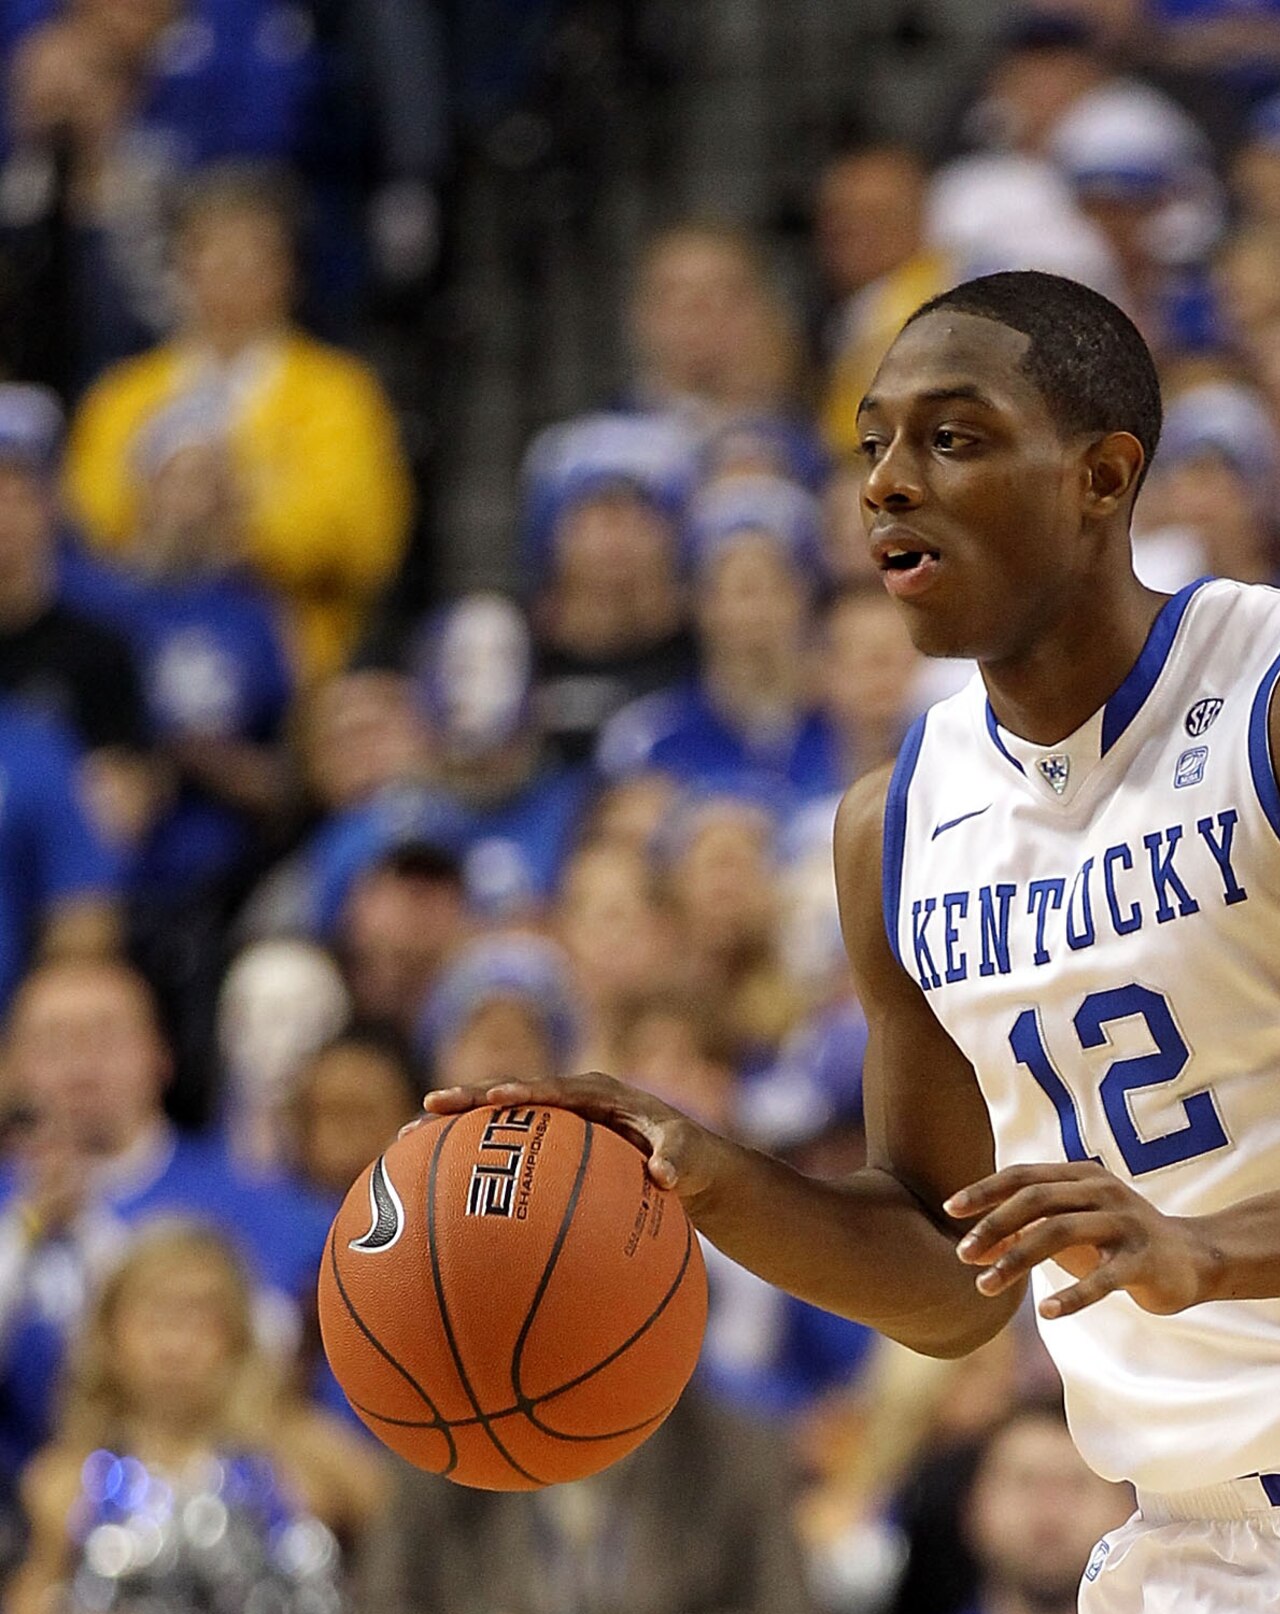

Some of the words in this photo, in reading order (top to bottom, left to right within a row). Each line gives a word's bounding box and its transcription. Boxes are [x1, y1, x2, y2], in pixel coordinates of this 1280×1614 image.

[911, 809, 1247, 991] KENTUCKY
[465, 1108, 536, 1217] ELITE
[1008, 982, 1234, 1177] 12
